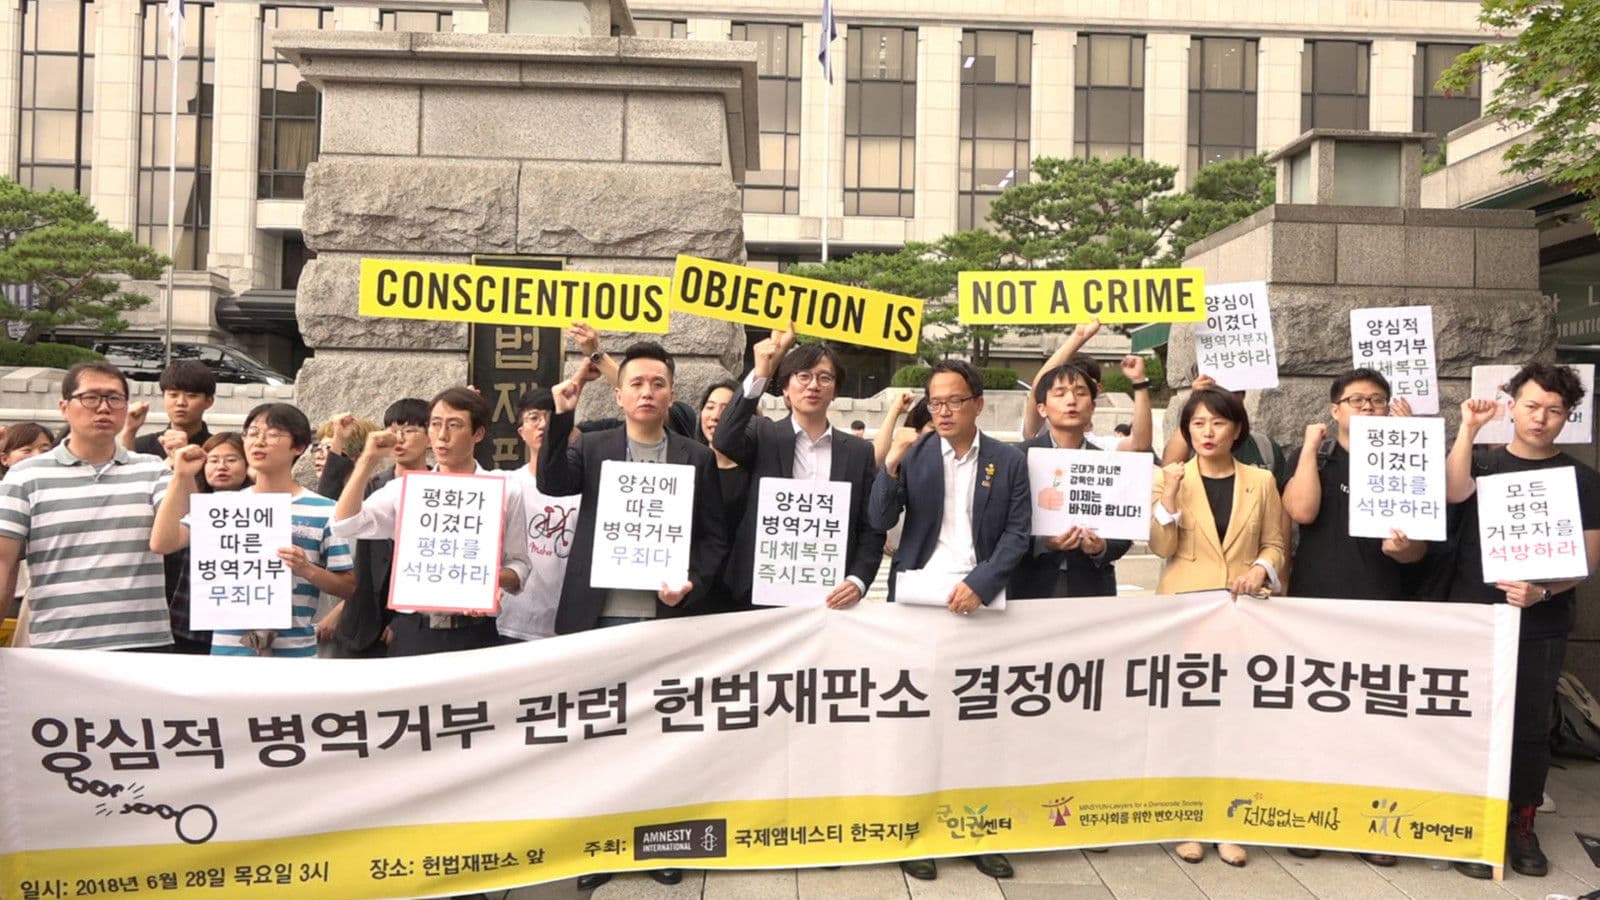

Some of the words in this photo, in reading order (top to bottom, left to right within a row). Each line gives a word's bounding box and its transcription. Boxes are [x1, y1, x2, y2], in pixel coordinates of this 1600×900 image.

[376, 268, 664, 323] CONSCIENTIOUS
[680, 265, 866, 335] OBJECTION
[882, 302, 916, 342] IS
[971, 281, 1036, 315] NOT
[1049, 280, 1071, 314] A
[1083, 277, 1196, 313] CRIME
[1204, 293, 1254, 312] 양심이
[1207, 313, 1258, 332] 이겼다
[1366, 318, 1418, 336] 양심적
[1200, 332, 1268, 350] 병역거부자
[1358, 338, 1428, 357] 병역거부
[1203, 348, 1271, 369] 석방하라
[1367, 429, 1428, 449] 평화가
[1367, 451, 1428, 472] 이겼다
[618, 474, 677, 495] 양심에
[1367, 474, 1428, 495] 평화를
[1506, 481, 1547, 498] 모든
[421, 487, 486, 511] 평화가
[775, 491, 834, 514] 양심적
[1069, 489, 1102, 503] 이제는
[208, 506, 274, 530] 양심에
[626, 498, 664, 518] 따른
[1105, 504, 1141, 518] 합니다!
[1357, 497, 1440, 519] 석방하라
[1507, 500, 1549, 520] 병역
[419, 511, 483, 535] 이겼다
[603, 521, 683, 544] 병역거부
[762, 515, 840, 538] 병역거부
[1487, 519, 1575, 541] 거부자를
[220, 533, 263, 553] 따른
[416, 535, 480, 560] 평화를
[760, 539, 839, 562] 대체복무
[1488, 540, 1579, 562] 석방하라
[611, 546, 671, 567] 무죄다
[198, 559, 287, 583] 병역거부
[403, 560, 490, 585] 석방하라
[758, 563, 837, 587] 즉시도입
[208, 582, 274, 606] 무죄다
[32, 717, 225, 773] 양심적
[249, 700, 495, 768] 병역거부
[516, 681, 628, 745] 관련
[653, 666, 931, 733] 헌법재판소
[951, 659, 1104, 722] 결정에
[1126, 652, 1227, 709] 대한
[1246, 654, 1473, 719] 입장발표
[1080, 811, 1129, 827] 민주사회를
[1132, 810, 1152, 823] 위한
[1155, 808, 1204, 822] 변호사모임
[583, 838, 627, 858] 주최:
[734, 826, 844, 849] 국제앰네스티
[851, 820, 921, 844] 한국지부
[643, 829, 692, 842] AMNESTY
[1409, 820, 1474, 843] 참여연대
[643, 842, 692, 852] INTERNATIONAL
[370, 858, 415, 880] 장소:
[422, 851, 520, 877] 헌법재판소
[525, 848, 546, 865] 앞
[20, 879, 69, 899] 일시:
[75, 875, 140, 897] 2018년
[146, 872, 179, 890] 6월
[184, 866, 226, 888] 28일
[233, 863, 293, 886] 목요일
[299, 861, 329, 883] 3시
